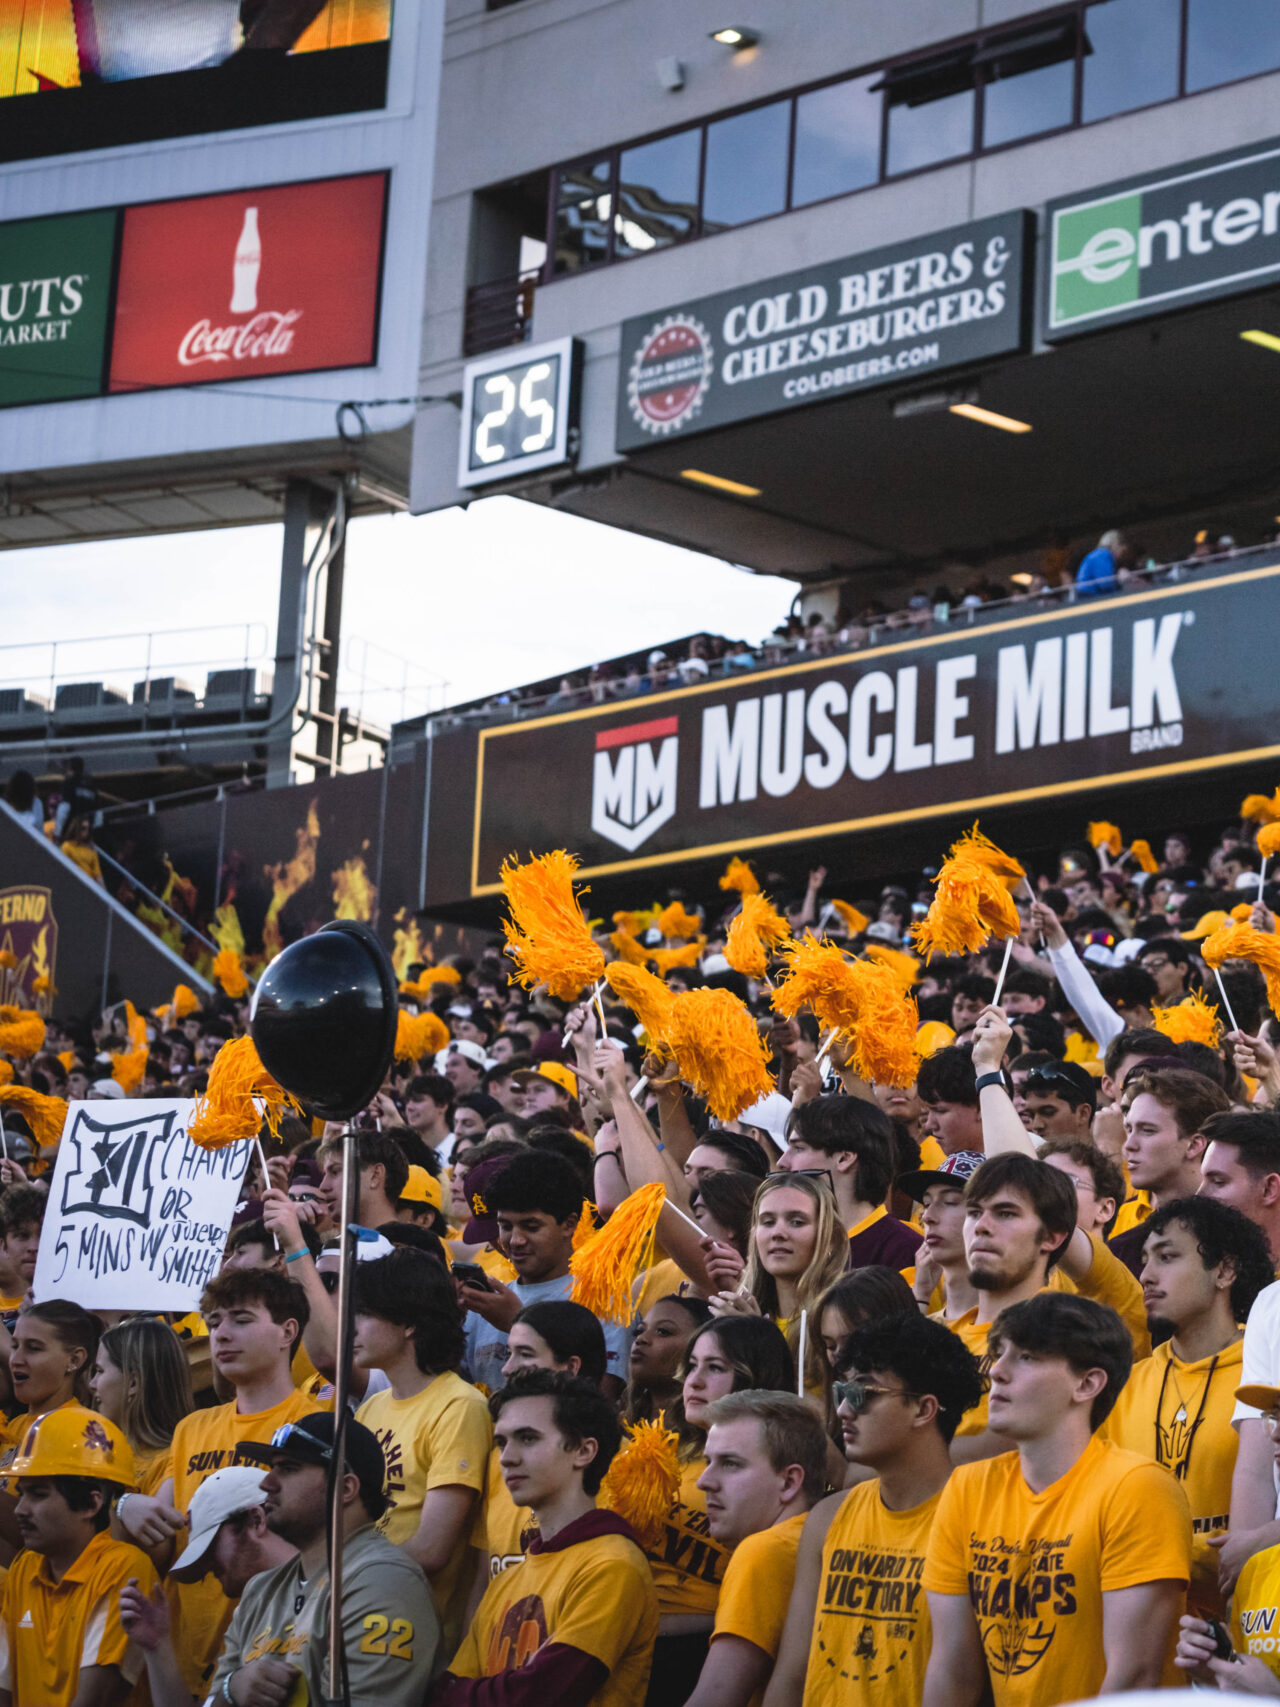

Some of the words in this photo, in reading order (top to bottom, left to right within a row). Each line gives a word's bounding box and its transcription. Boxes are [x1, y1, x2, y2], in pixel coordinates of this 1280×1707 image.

[0, 274, 84, 323] UTS
[722, 284, 829, 346] COLD
[837, 241, 976, 316] BEERS
[982, 235, 1011, 278] &
[0, 318, 72, 346] ARKET
[722, 280, 1008, 385] CHEESEBURGERS
[783, 342, 940, 399] COLDBEERS.COM
[475, 362, 554, 464] 25
[699, 654, 977, 809] MUSCLE
[995, 611, 1184, 755] MILK
[1129, 722, 1184, 755] BRAND
[0, 894, 47, 925] ERNO
[159, 1186, 193, 1220] OR
[53, 1224, 76, 1283] 5
[77, 1222, 136, 1280] MINS
[186, 1450, 226, 1476] SUN
[829, 1548, 907, 1579] ONWARD
[360, 1613, 413, 1661] 22
